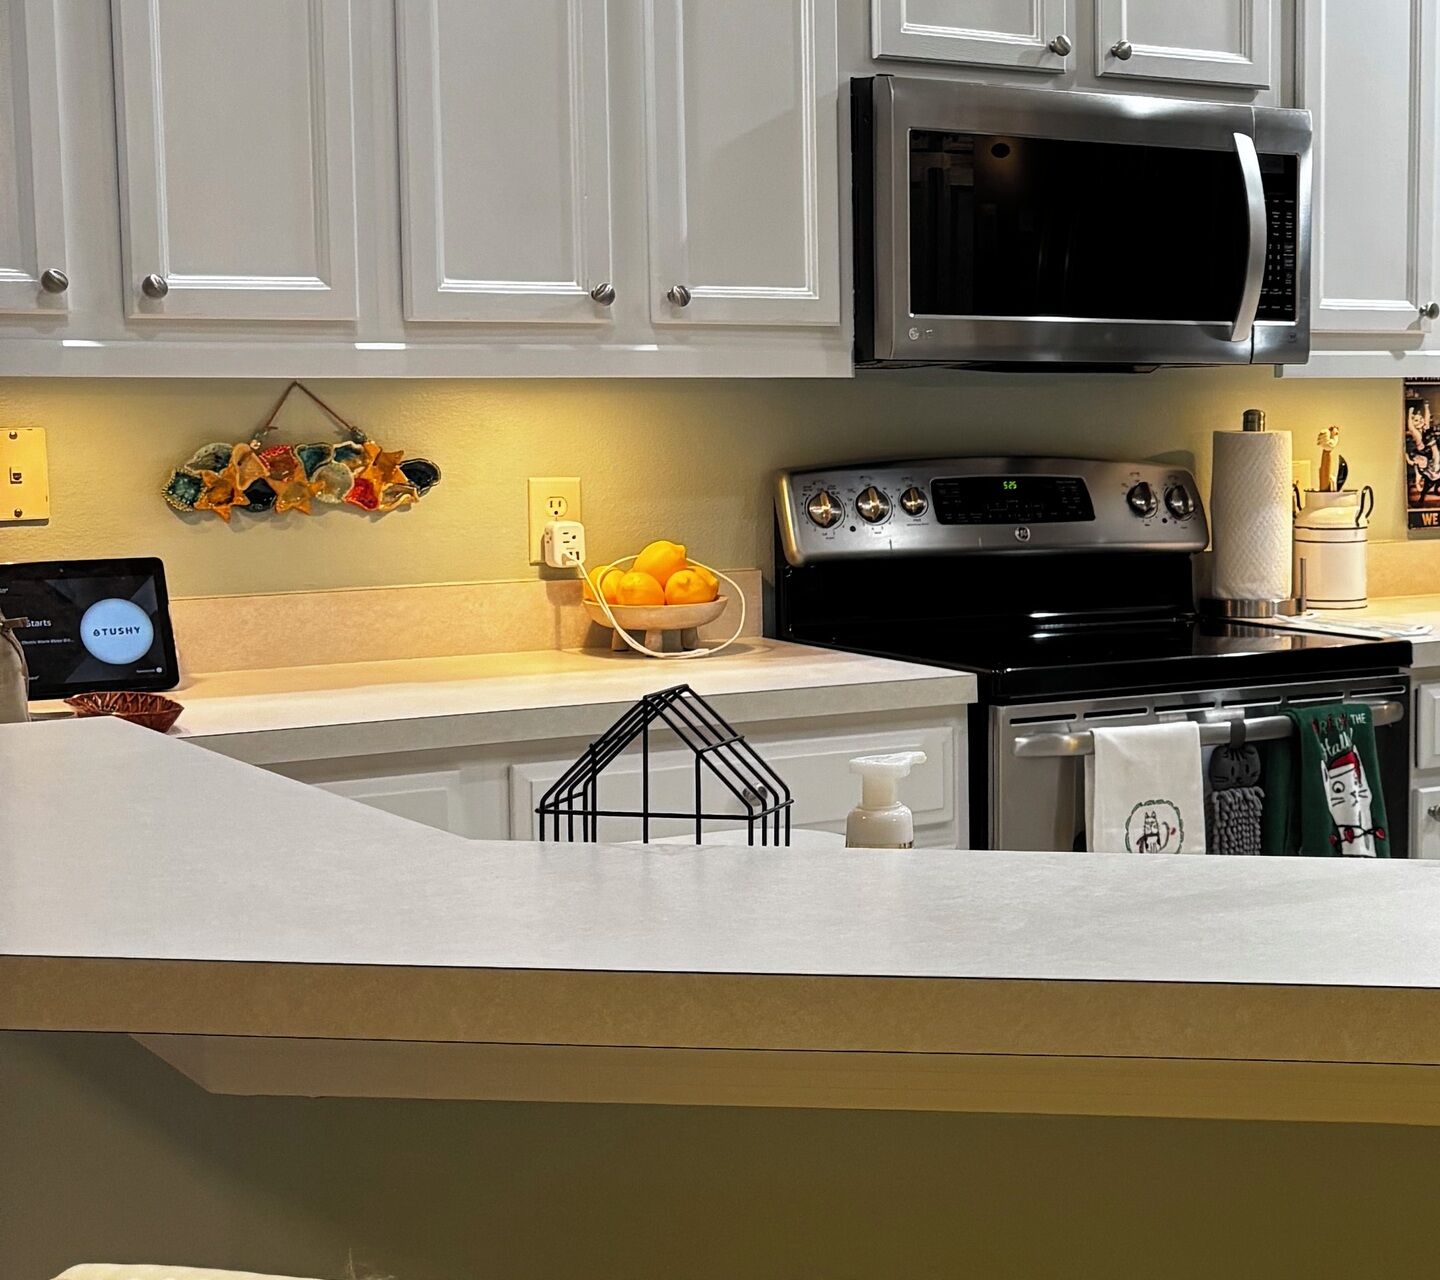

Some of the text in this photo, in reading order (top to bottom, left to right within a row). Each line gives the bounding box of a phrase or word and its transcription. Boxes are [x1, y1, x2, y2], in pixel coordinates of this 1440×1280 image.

[1422, 513, 1439, 526] WE
[102, 626, 141, 637] TUSHY
[1350, 713, 1367, 725] THE
